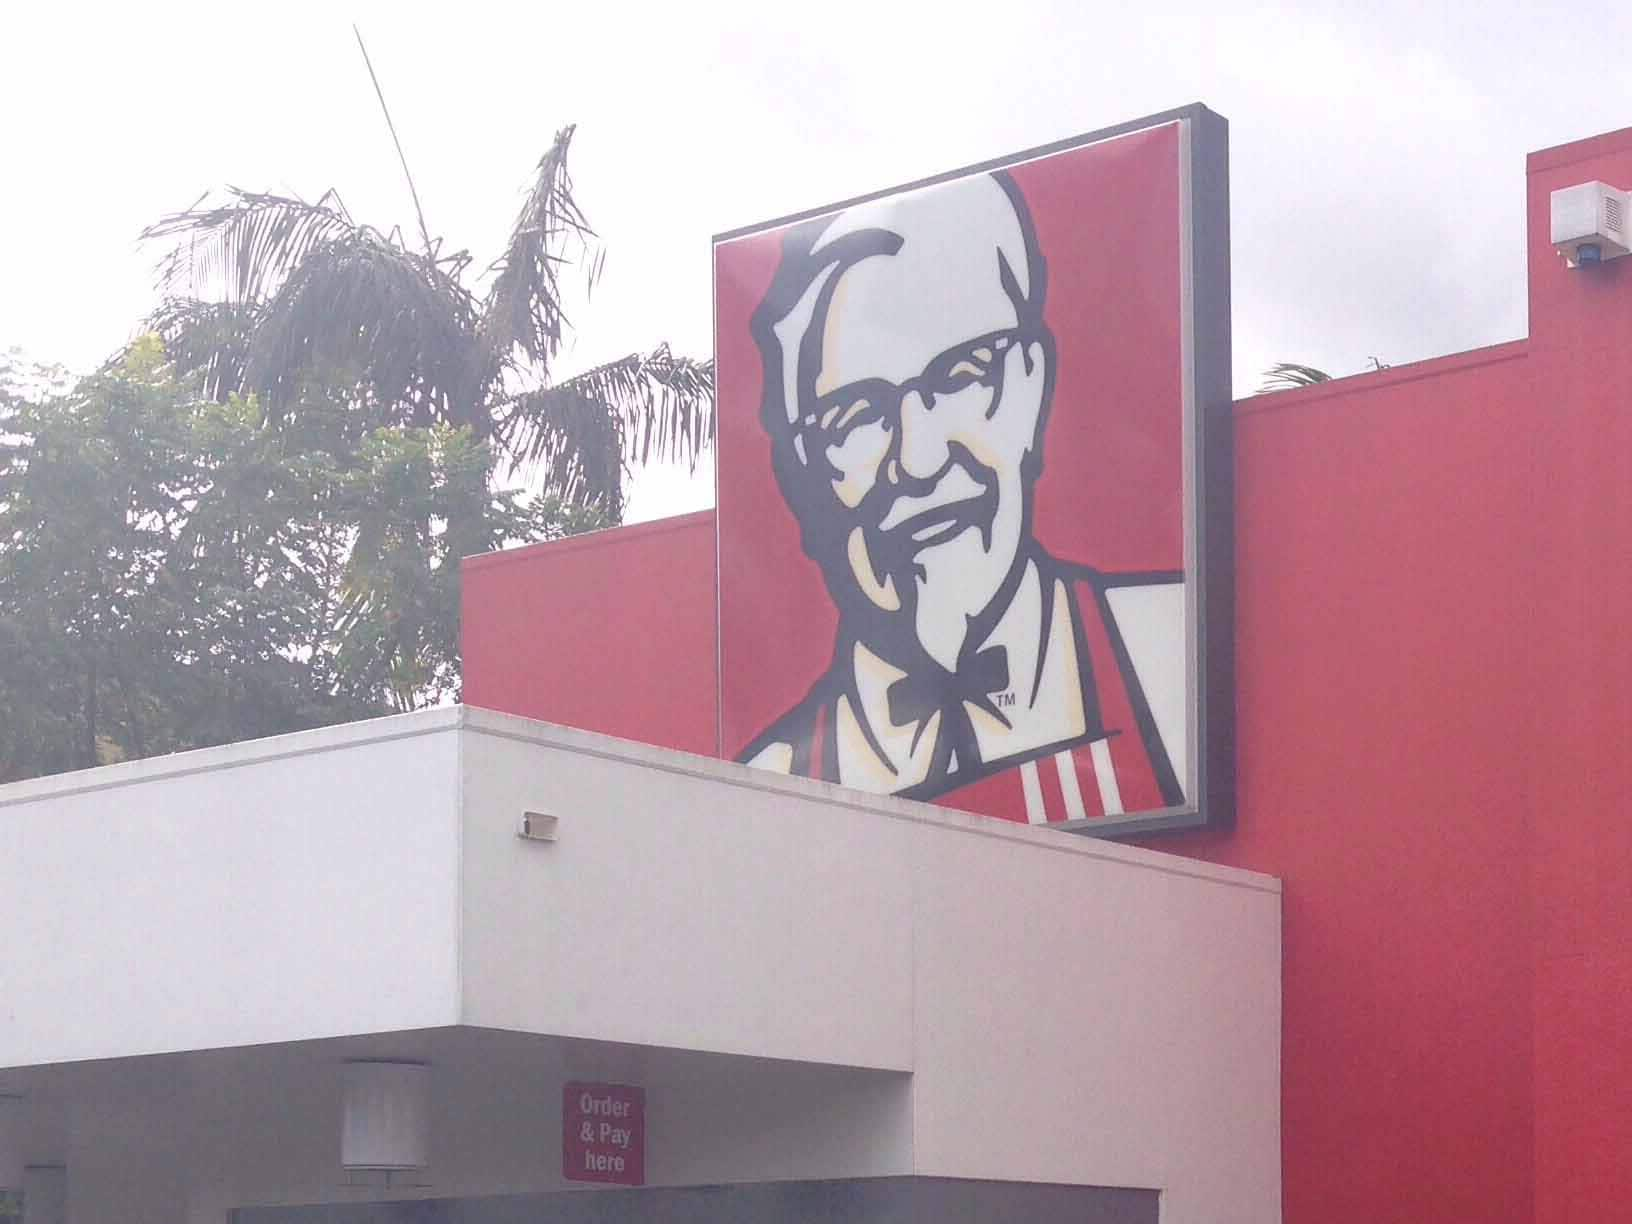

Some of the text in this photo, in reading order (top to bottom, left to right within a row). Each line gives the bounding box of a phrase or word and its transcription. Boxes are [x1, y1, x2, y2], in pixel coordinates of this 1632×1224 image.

[996, 693, 1016, 707] TM
[581, 1094, 632, 1117] Order
[581, 1121, 632, 1149] & Pay
[585, 1150, 625, 1171] here
